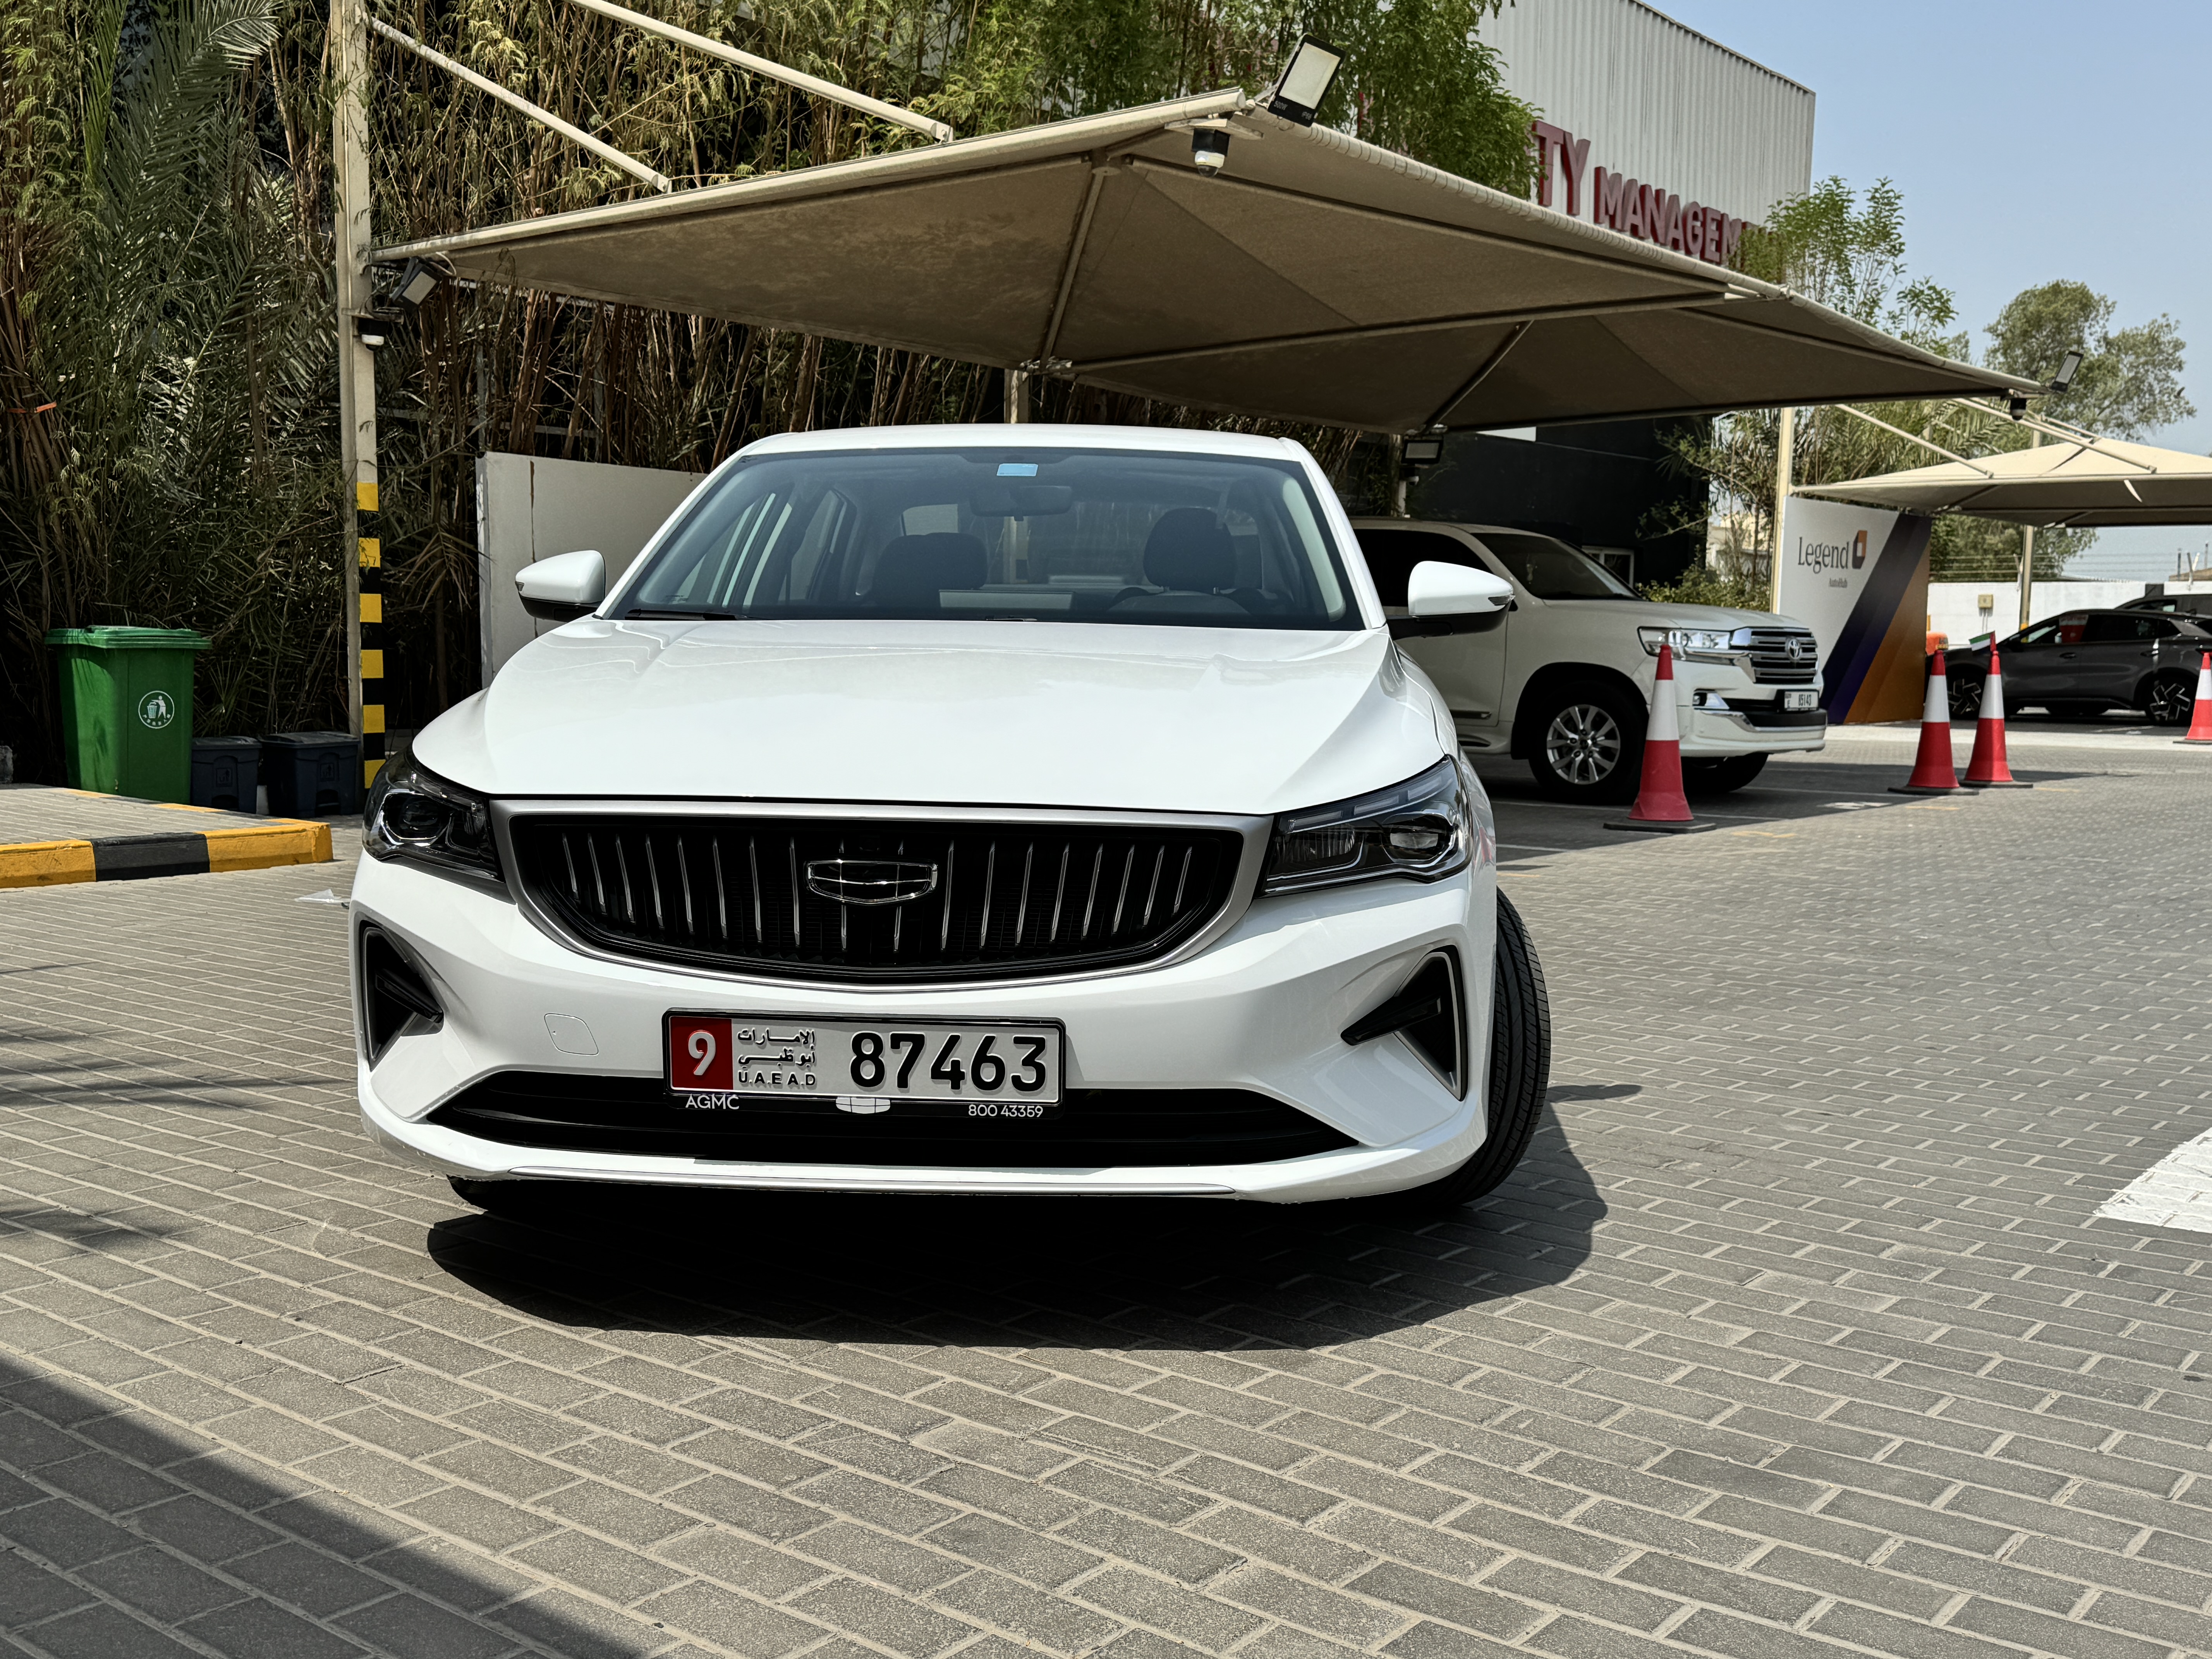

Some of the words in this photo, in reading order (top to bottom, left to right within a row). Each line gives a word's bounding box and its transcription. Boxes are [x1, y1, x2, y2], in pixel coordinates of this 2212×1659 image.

[1525, 120, 1591, 216] TY
[1594, 166, 1769, 271] MANAGEM
[1798, 536, 1849, 574] Legend
[688, 1030, 716, 1076] 9
[850, 1031, 1046, 1092] 87463
[685, 1094, 739, 1109] AGMC
[968, 1104, 998, 1116] 800
[1000, 1105, 1043, 1118] 43359
